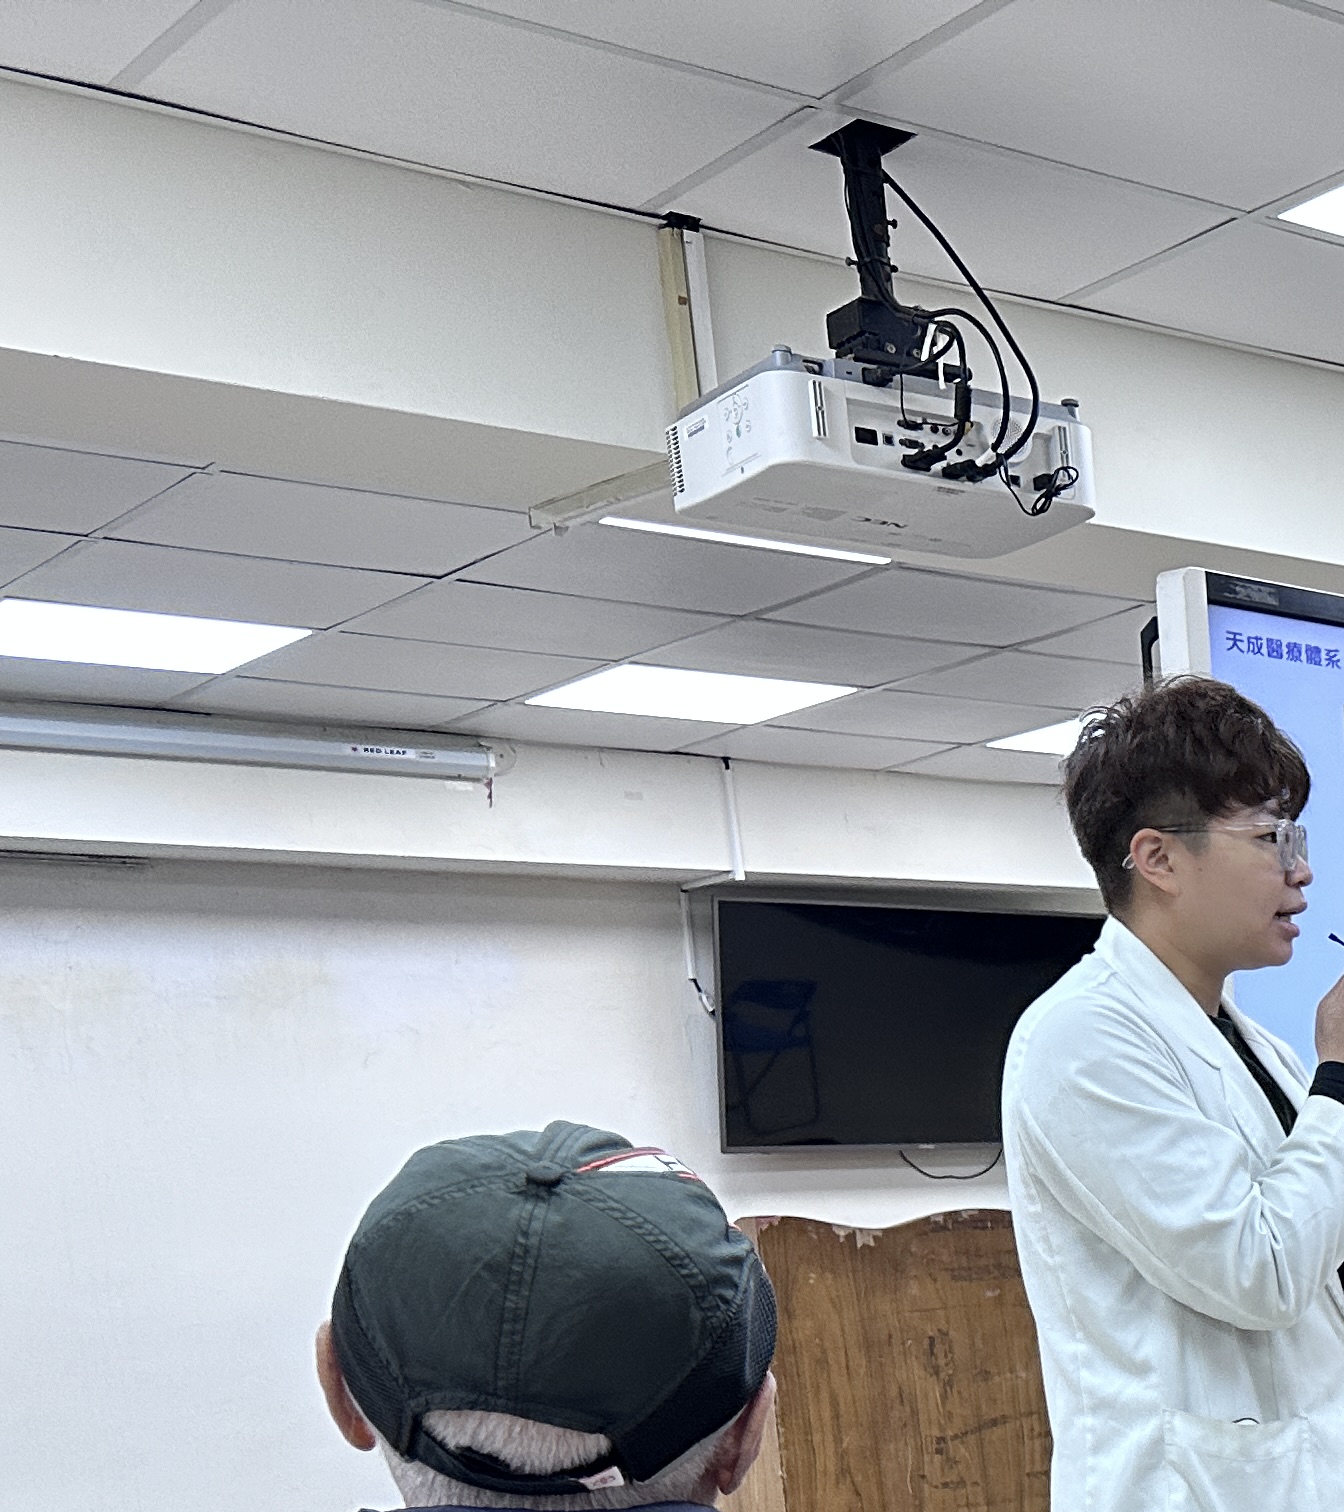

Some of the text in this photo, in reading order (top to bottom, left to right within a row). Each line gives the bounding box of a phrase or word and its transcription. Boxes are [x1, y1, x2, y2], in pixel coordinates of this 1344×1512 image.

[1225, 630, 1342, 670] 天成醫療體系
